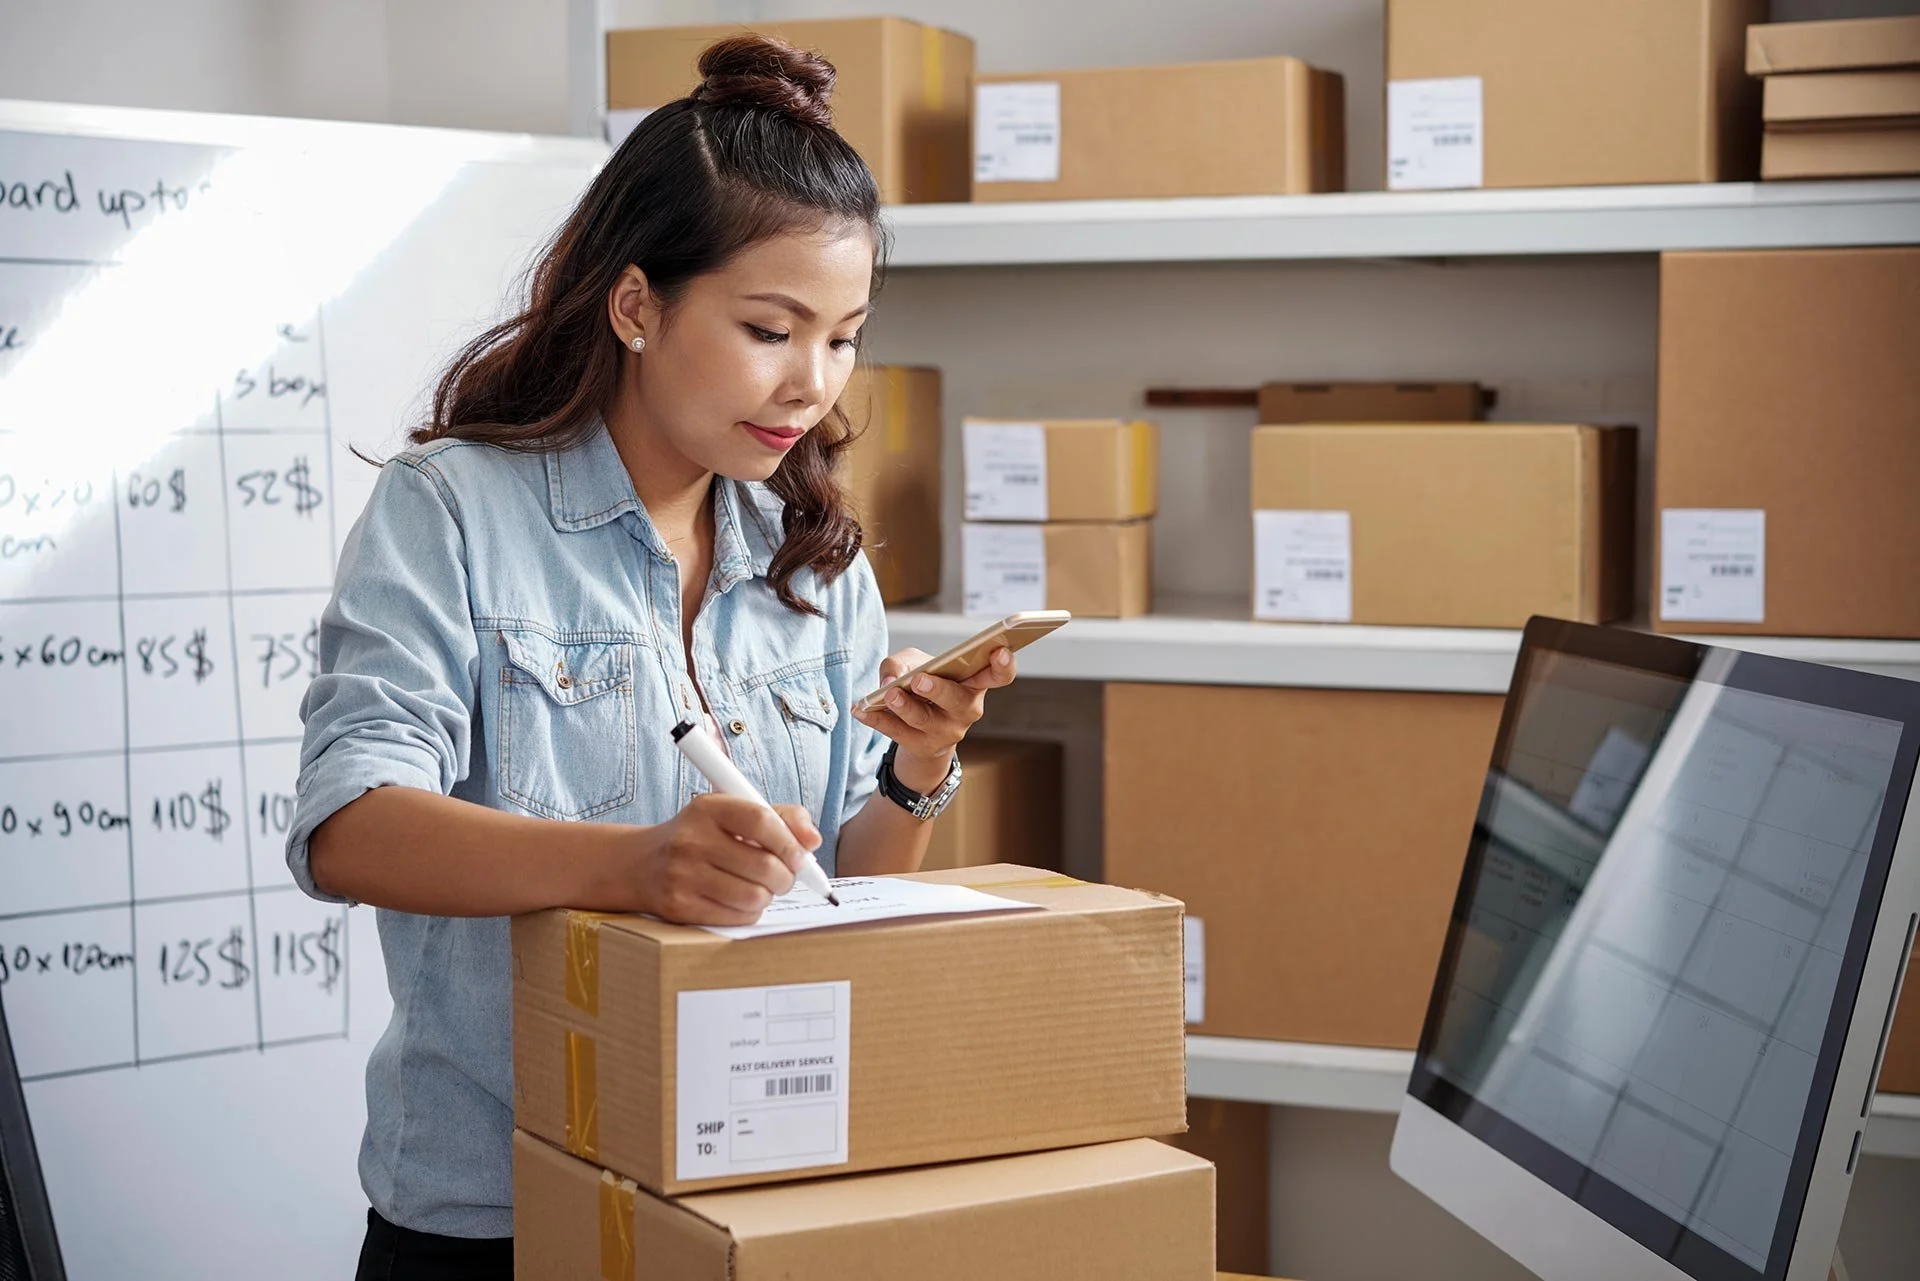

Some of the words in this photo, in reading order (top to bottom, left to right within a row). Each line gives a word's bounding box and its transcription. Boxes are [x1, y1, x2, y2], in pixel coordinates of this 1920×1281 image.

[268, 364, 327, 410] box
[128, 469, 187, 513] 60$
[236, 456, 323, 519] 52$
[136, 626, 214, 684] 85$
[151, 779, 231, 842] 110$
[159, 926, 251, 990] 125$
[273, 917, 342, 994] 115$
[730, 1062, 753, 1073] FAST
[753, 1058, 796, 1072] DELIVERY
[798, 1055, 834, 1067] SERVICE
[696, 1121, 725, 1136] SHIP
[697, 1142, 717, 1157] TO:
